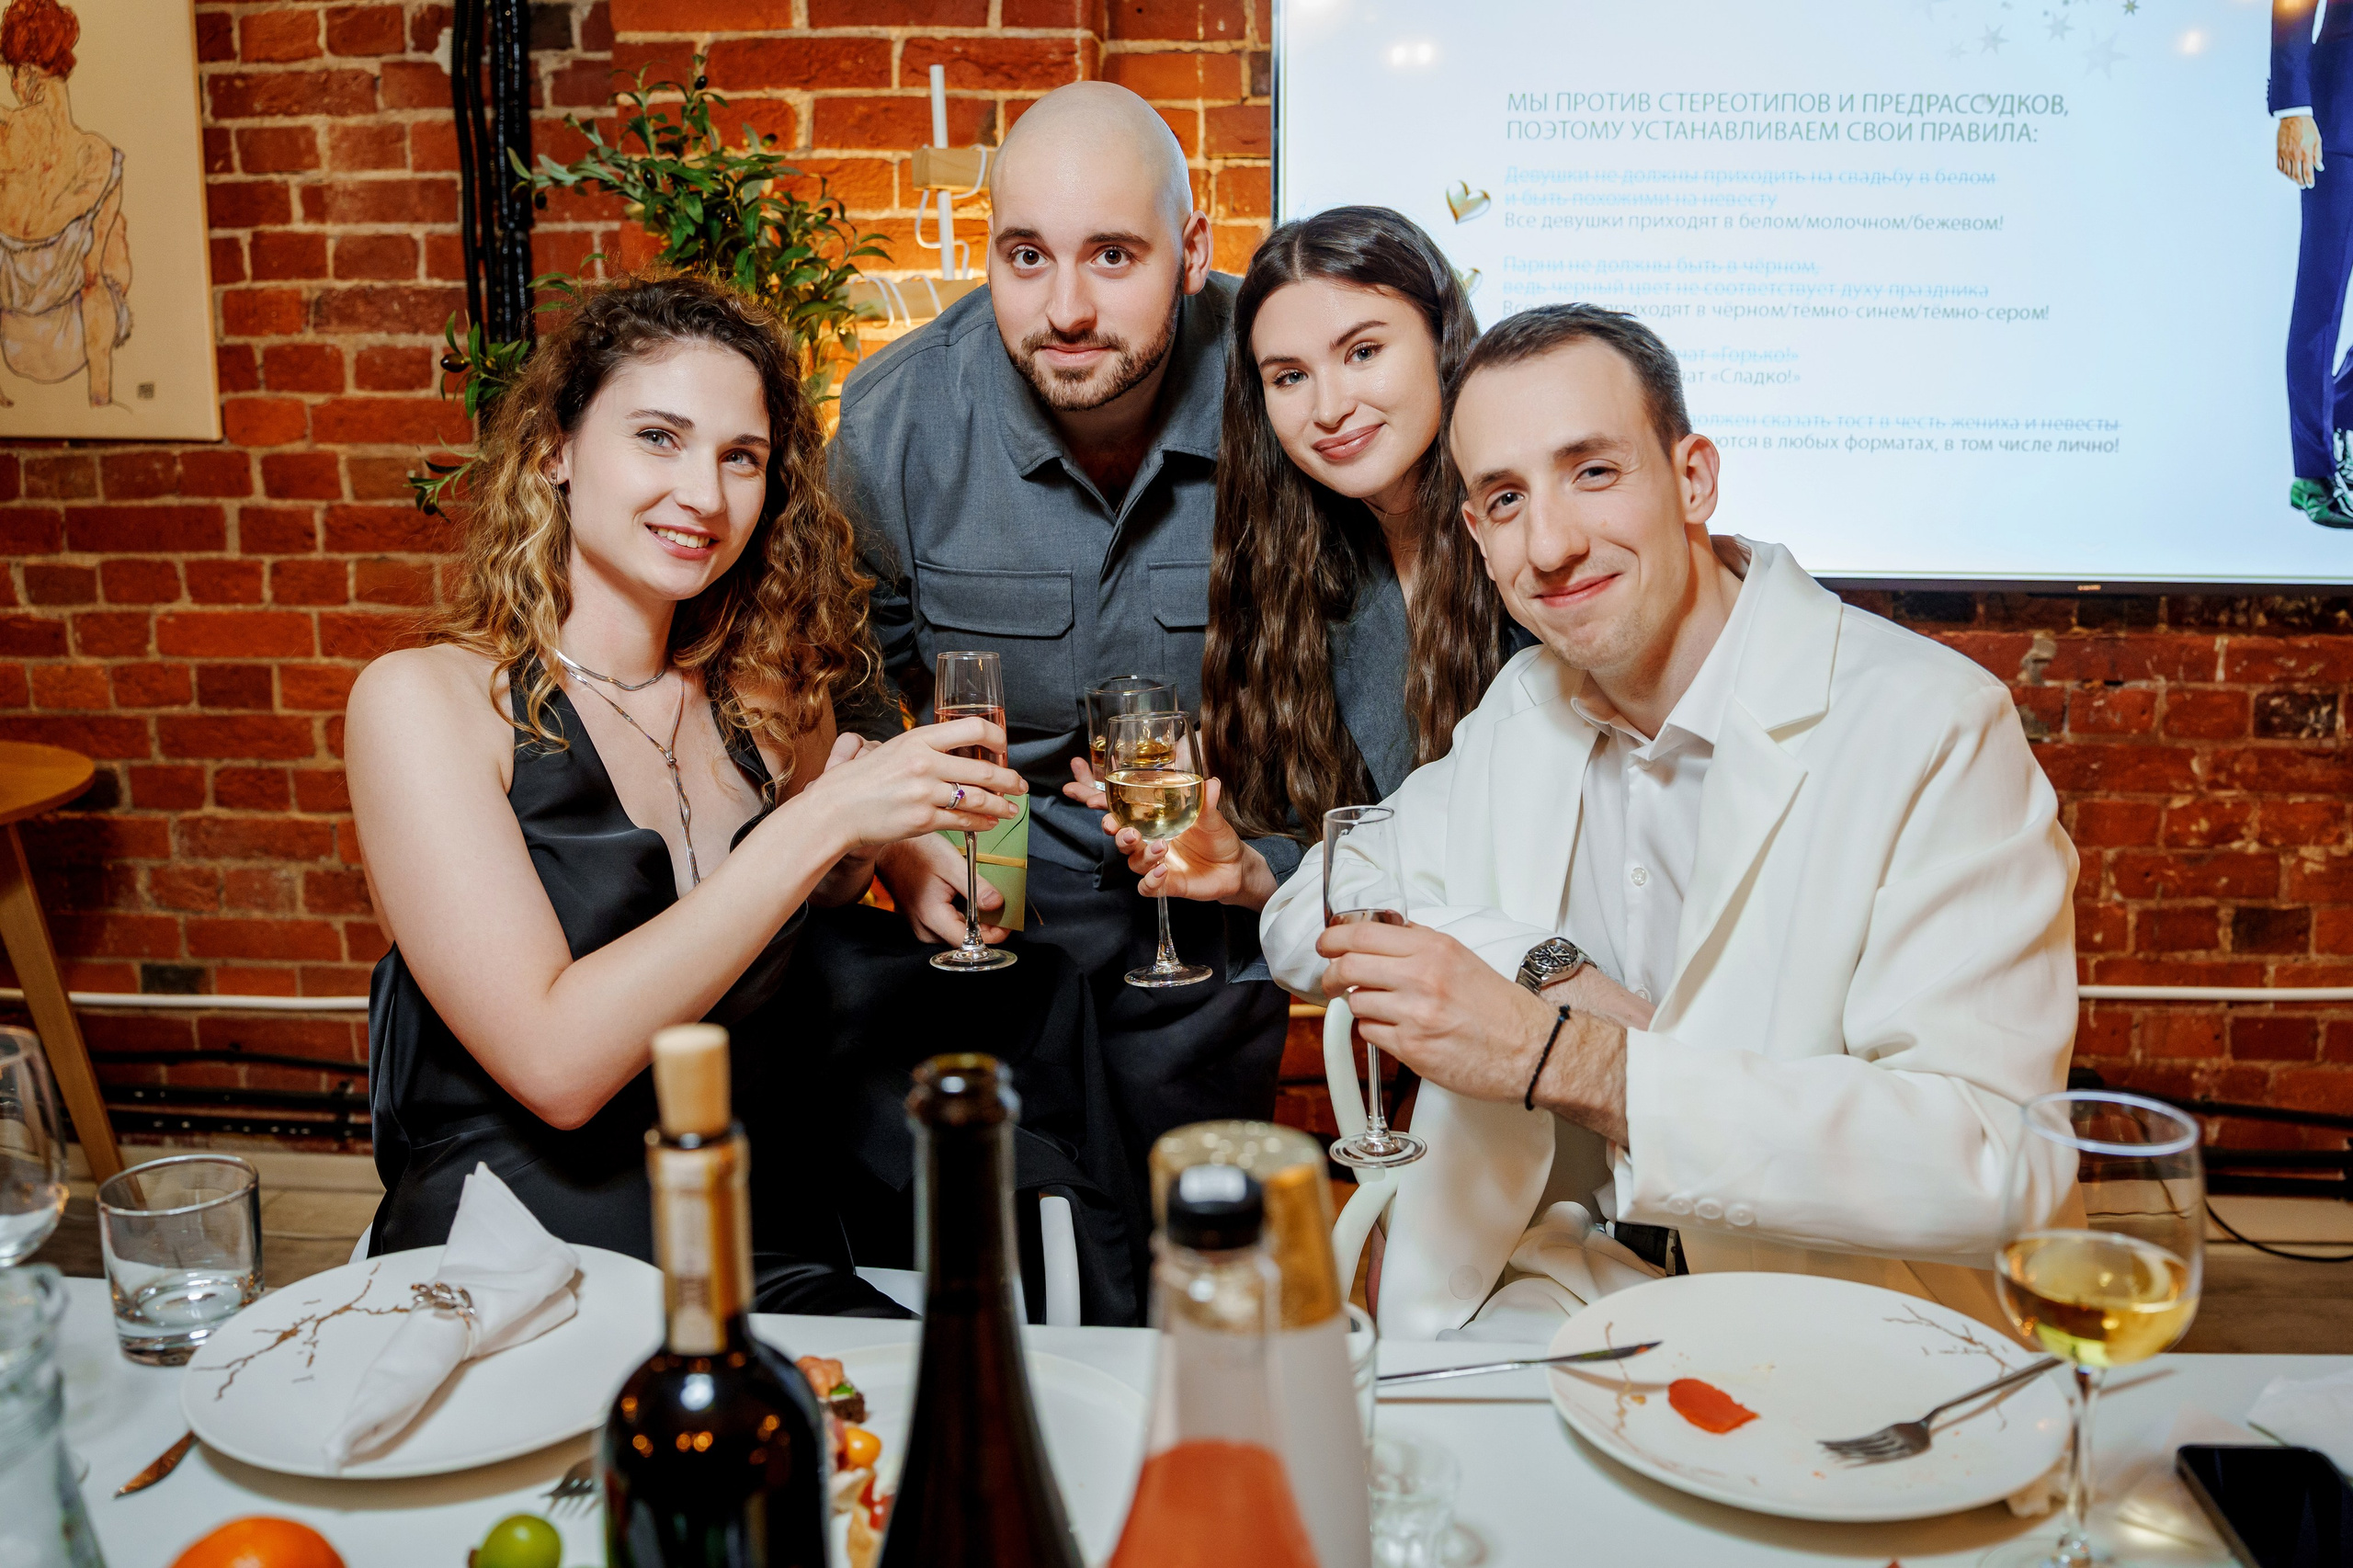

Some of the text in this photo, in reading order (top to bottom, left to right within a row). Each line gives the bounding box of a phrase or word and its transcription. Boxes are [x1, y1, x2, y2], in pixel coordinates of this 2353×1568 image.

[1507, 92, 2069, 118] МЫ ПРОТИВ СТЕРЕОТИПОВ И ПРЕДРАССУДКОВ,
[1507, 120, 2039, 143] ПОЭТОМУ УСТАНАВЛИВАЕМ СВОИ ПРАВИЛА:
[1505, 165, 1996, 187] Девушки не должны приходить на свадьбу в белом
[1505, 188, 1779, 210] и быть похожими на невесту
[1505, 212, 2004, 233] Все девушки приходят в белом/молочном/бежевом!
[1504, 256, 1563, 276] Парни
[1569, 259, 1592, 273] не
[1596, 258, 1671, 276] должны
[1676, 254, 1721, 274] быть
[1726, 261, 1737, 274] в
[1676, 282, 1699, 296] не
[1840, 284, 1884, 301] духу
[1889, 284, 1989, 301] праздника
[1696, 305, 1707, 318] в
[1711, 368, 1801, 386] «Сладко!»
[1761, 415, 1831, 428] сказать
[1837, 415, 1874, 428] тост
[1880, 416, 1890, 429] в
[1895, 415, 1946, 430] честь
[1950, 417, 2019, 430] жениха
[2024, 418, 2037, 430] и
[2040, 418, 2121, 432] невесты
[1762, 437, 1773, 449] в
[1777, 432, 1839, 449] любых
[1844, 433, 1939, 454] форматах,
[1944, 437, 1955, 451] в
[1960, 438, 1994, 451] том
[1998, 438, 2053, 452] числе
[2055, 436, 2120, 454] лично!
